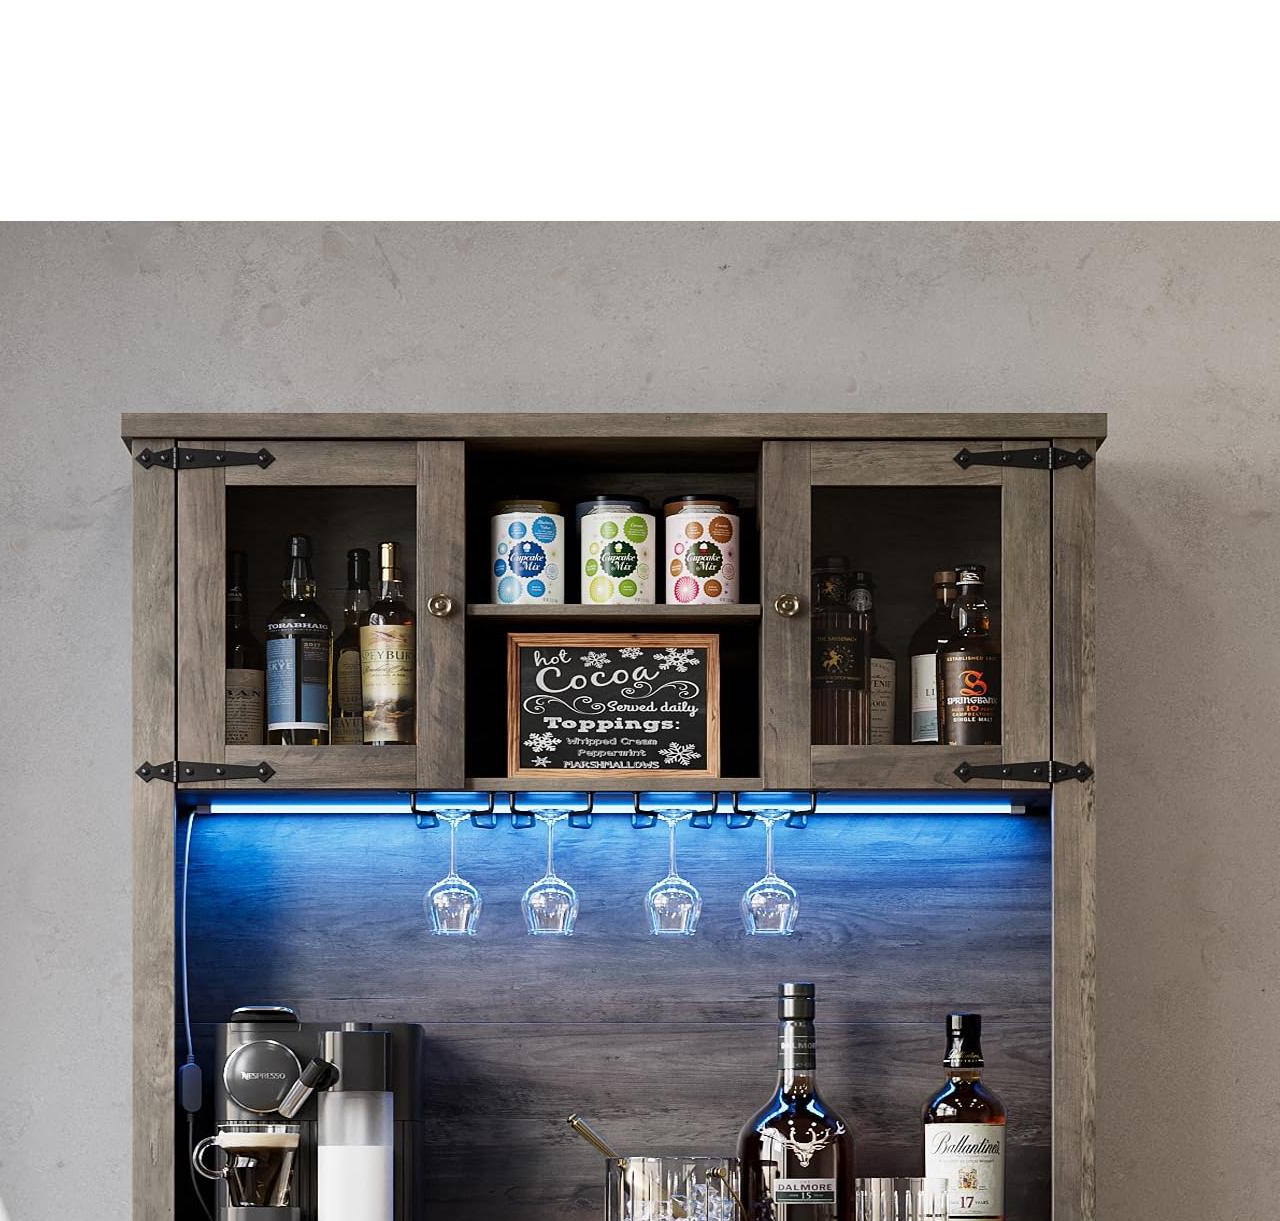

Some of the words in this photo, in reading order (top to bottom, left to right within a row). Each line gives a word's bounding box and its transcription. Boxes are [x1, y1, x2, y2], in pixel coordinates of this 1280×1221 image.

[267, 621, 329, 631] TORABHAIG
[533, 649, 573, 667] hot
[535, 666, 660, 693] Cocoa
[607, 701, 658, 713] Served
[660, 701, 699, 717] daily
[543, 716, 681, 733] Toppings:
[566, 737, 617, 746] Whipped
[577, 748, 647, 757] Peppermint
[562, 760, 660, 769] MARSHMALLOWS
[240, 1071, 287, 1081] NESPRESSO
[778, 1183, 833, 1191] DALMORE
[801, 1191, 812, 1199] 15
[960, 1196, 975, 1209] 17
